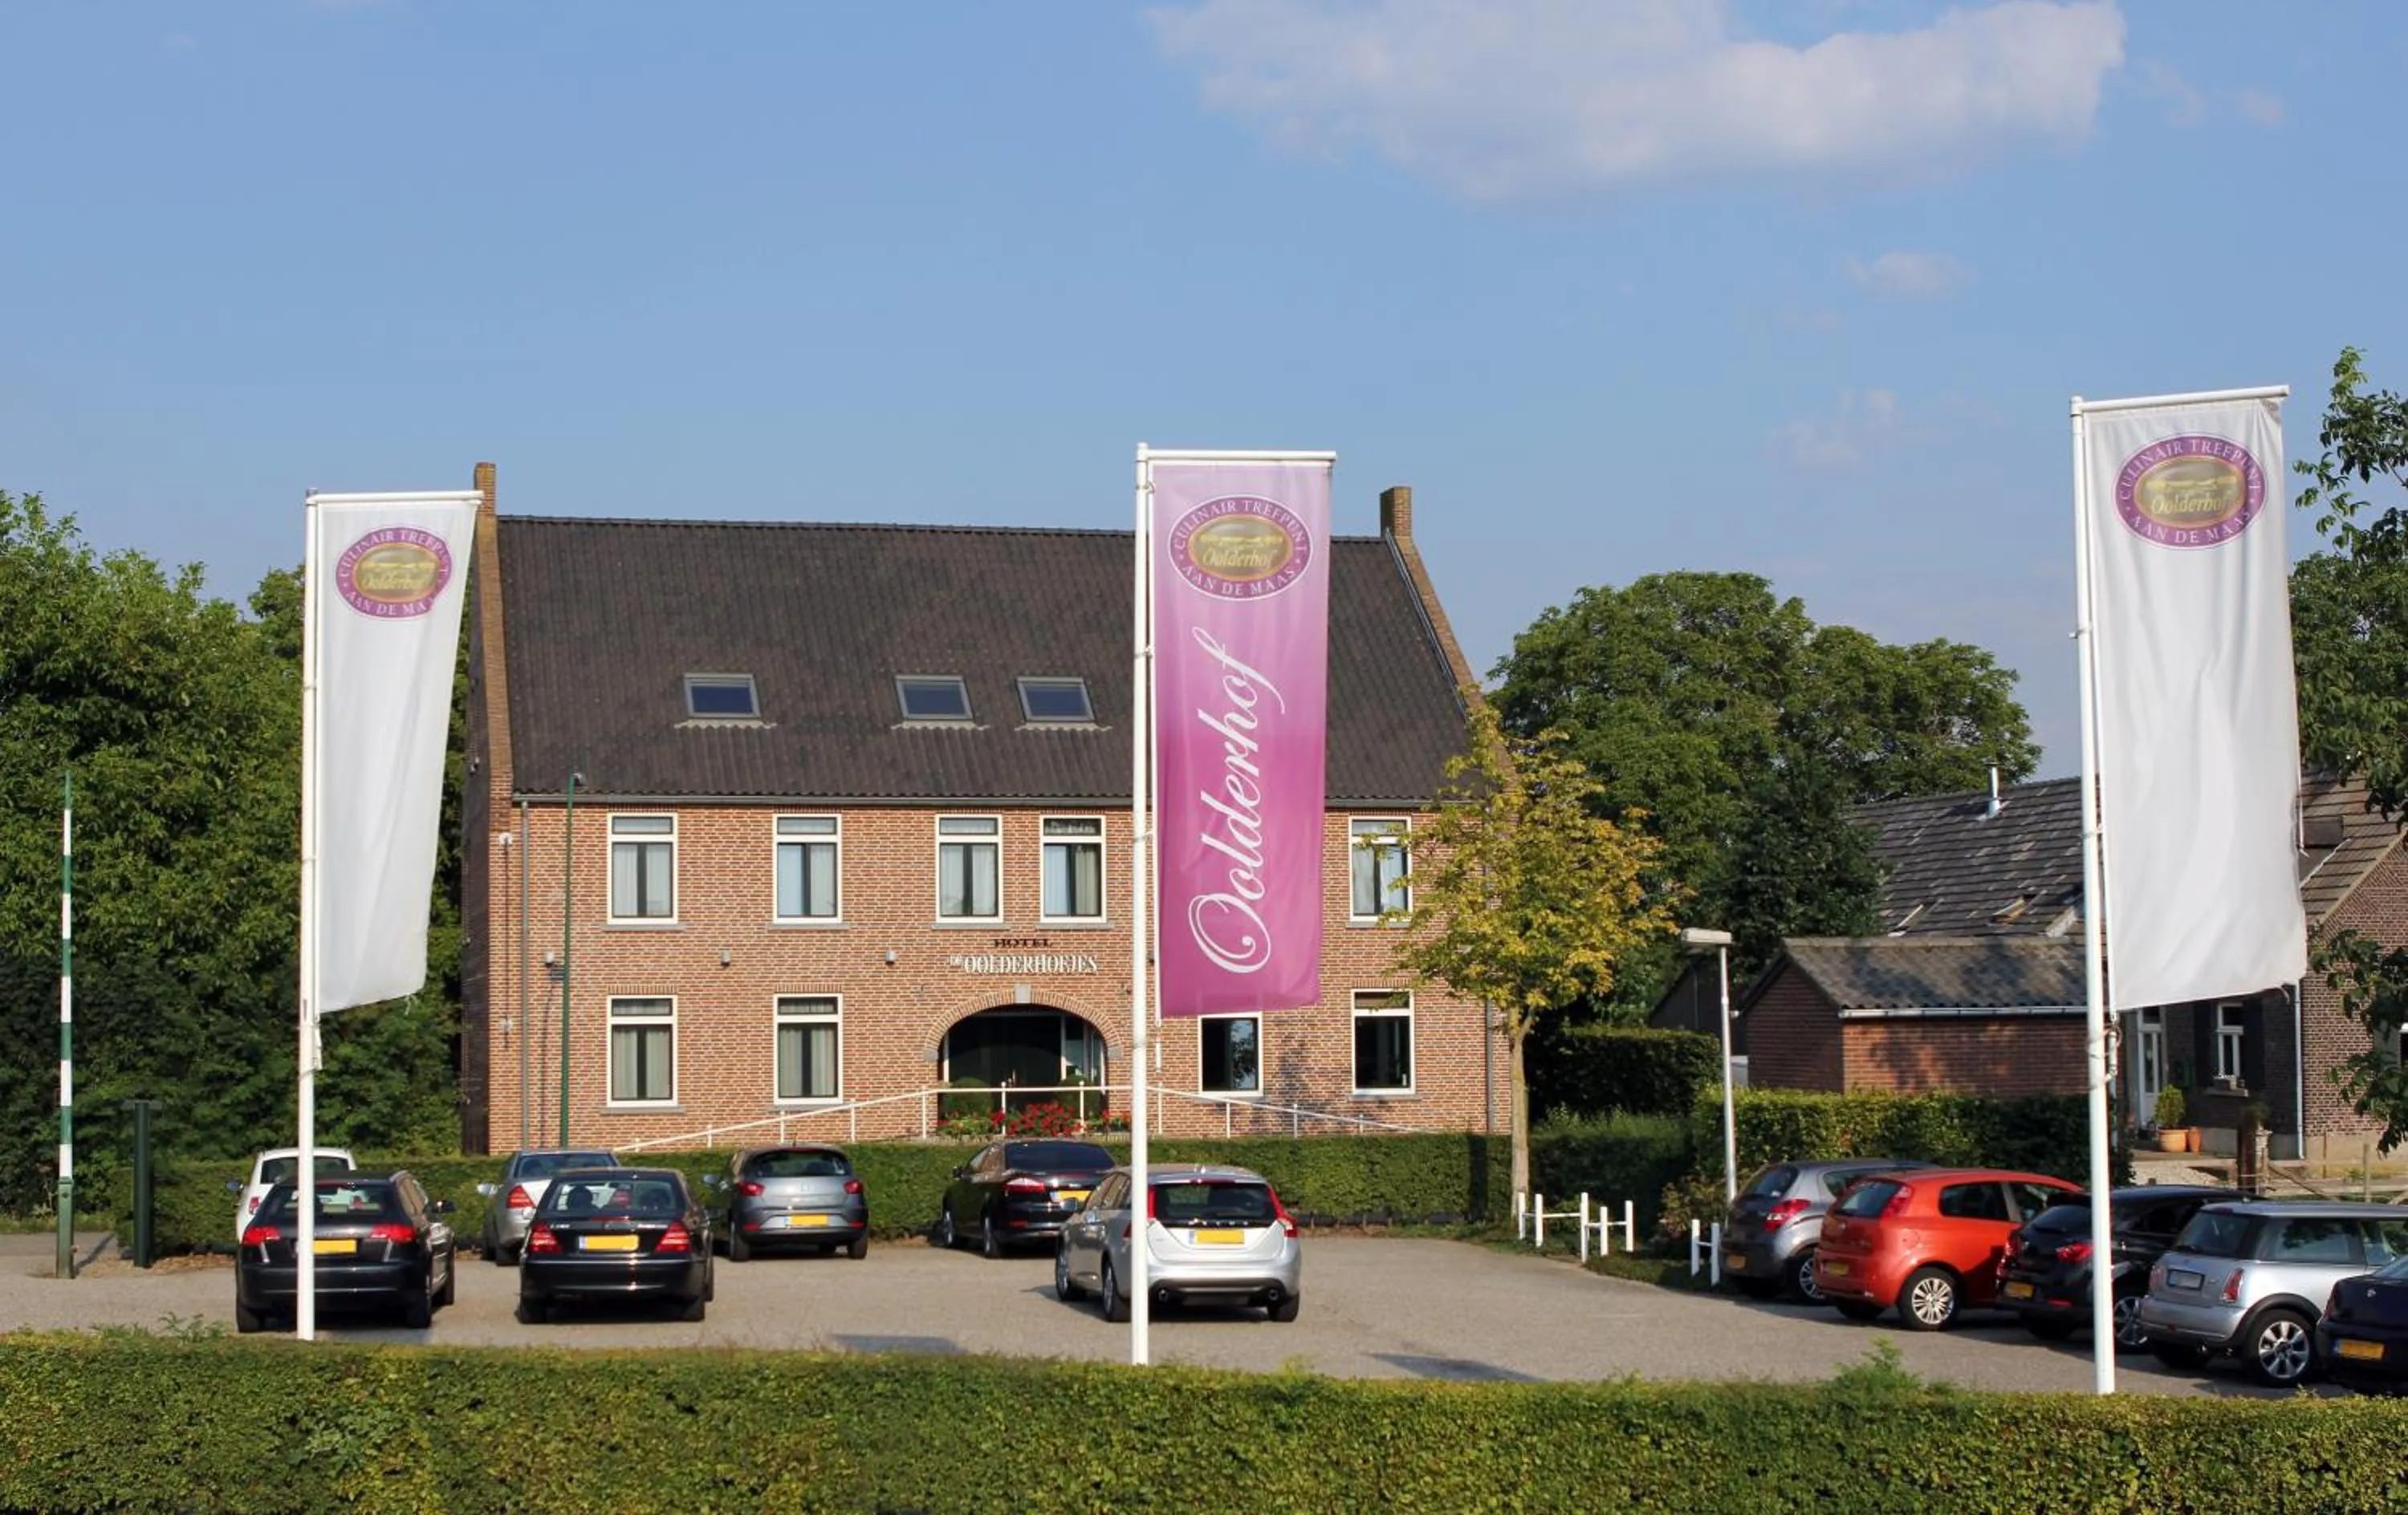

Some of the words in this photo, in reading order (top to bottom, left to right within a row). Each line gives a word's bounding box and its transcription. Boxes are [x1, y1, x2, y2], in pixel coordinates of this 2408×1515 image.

[2120, 441, 2183, 499] CULINAIR
[1174, 500, 1237, 550] CULINAIR
[1242, 500, 1308, 554] TREFPUNT
[2174, 530, 2203, 543] DE
[1182, 565, 1217, 590] AAN
[1222, 583, 1244, 595] DE
[1250, 568, 1296, 595] MAAS
[376, 603, 397, 615] DE
[1188, 626, 1285, 973] Oolderhof
[994, 938, 1053, 949] HOTEL
